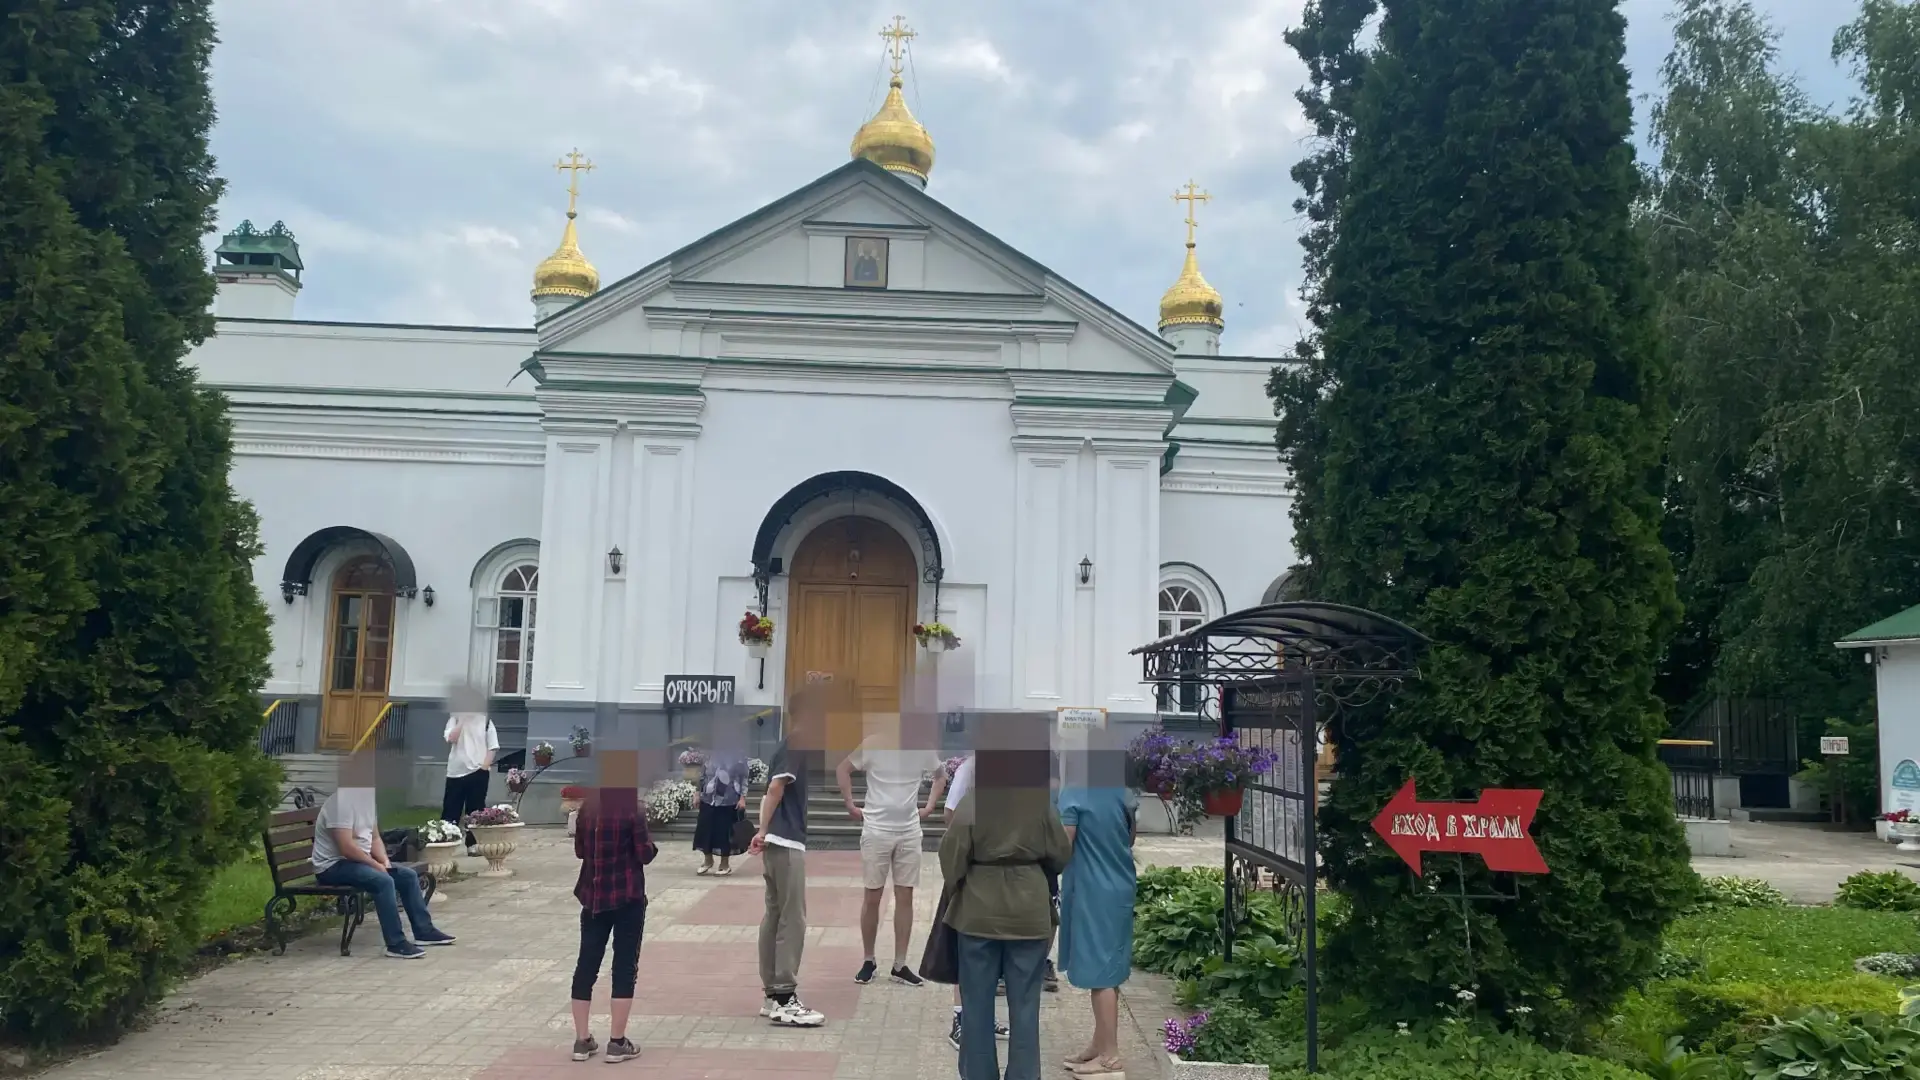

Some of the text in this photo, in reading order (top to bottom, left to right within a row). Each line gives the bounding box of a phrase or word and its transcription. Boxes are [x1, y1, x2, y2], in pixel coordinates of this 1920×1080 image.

[666, 680, 732, 704] ОТКРЫТ
[1391, 813, 1524, 841] ВХОД В ХРАМ
